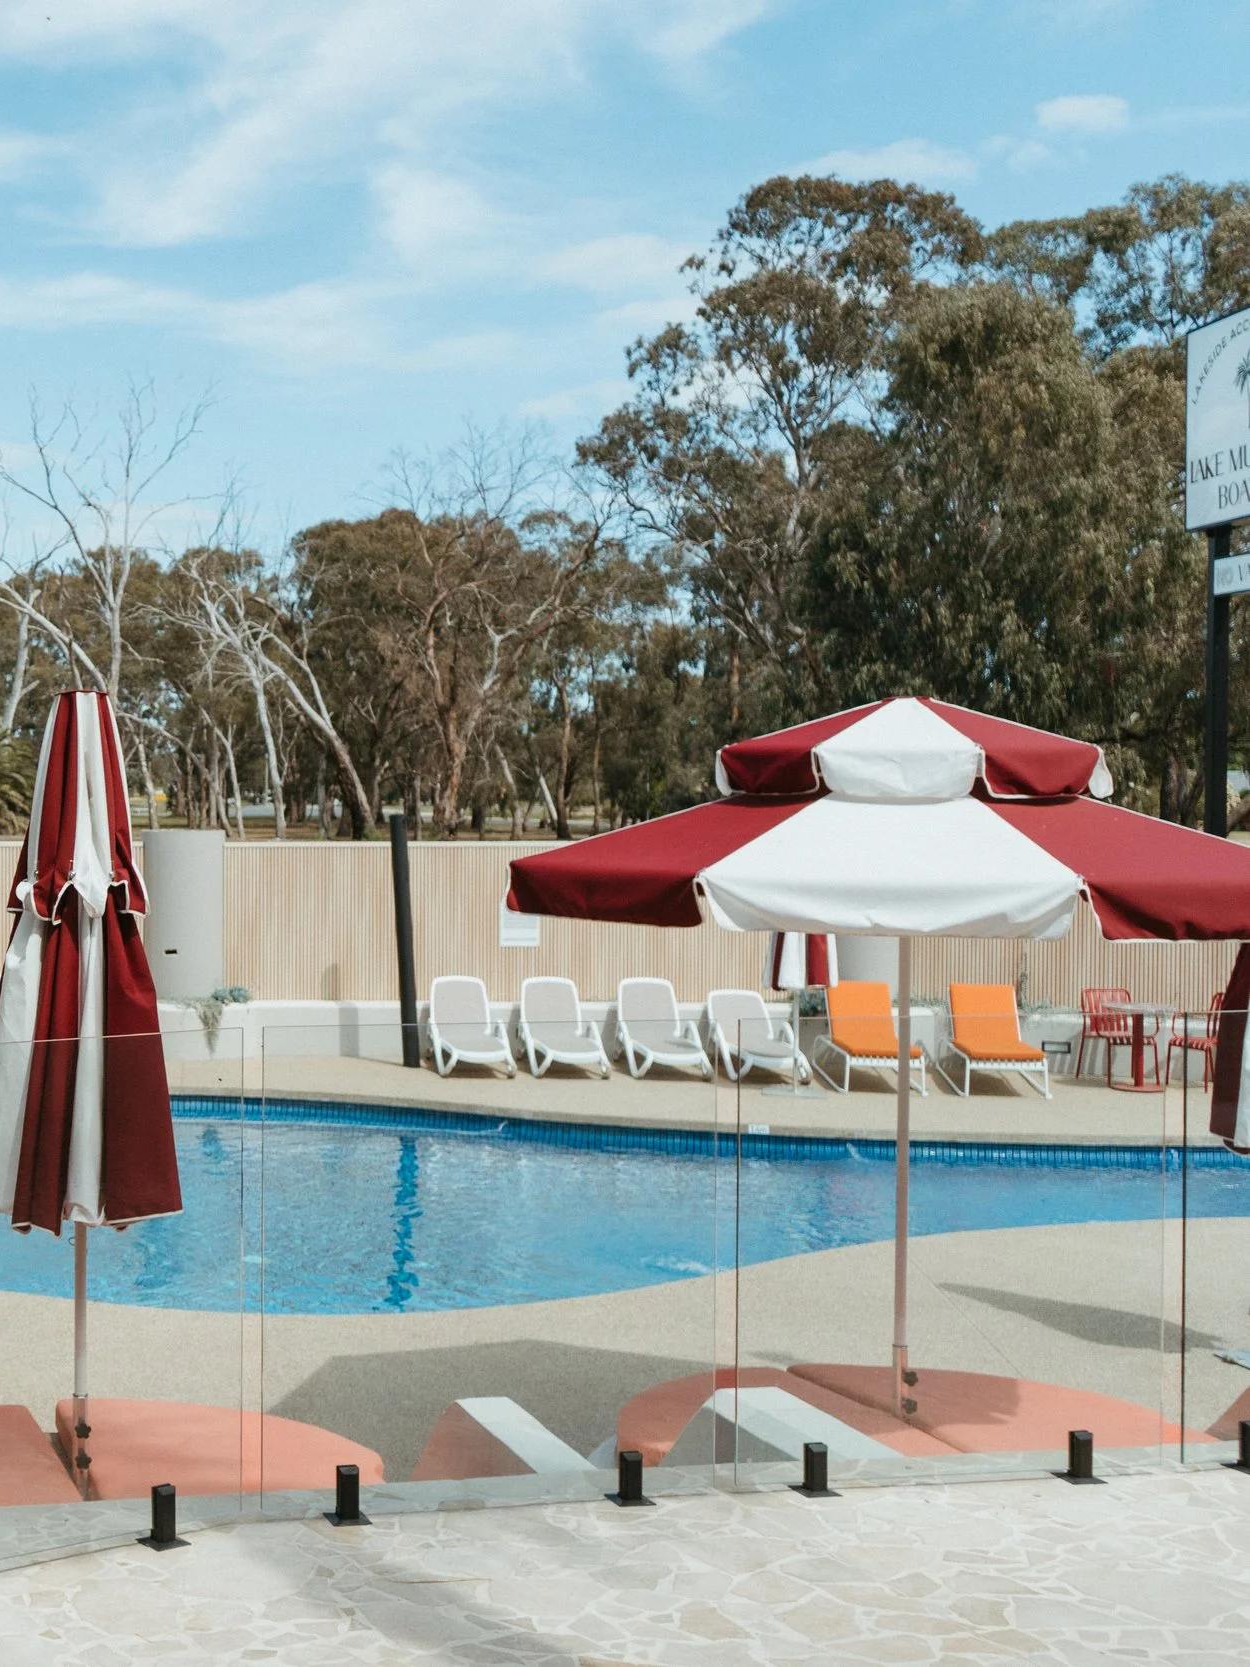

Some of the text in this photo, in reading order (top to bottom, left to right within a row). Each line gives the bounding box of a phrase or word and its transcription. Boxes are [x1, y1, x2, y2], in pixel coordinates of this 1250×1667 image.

[1191, 318, 1250, 405] LAKESIDE ACC
[1190, 450, 1224, 484] LAKE
